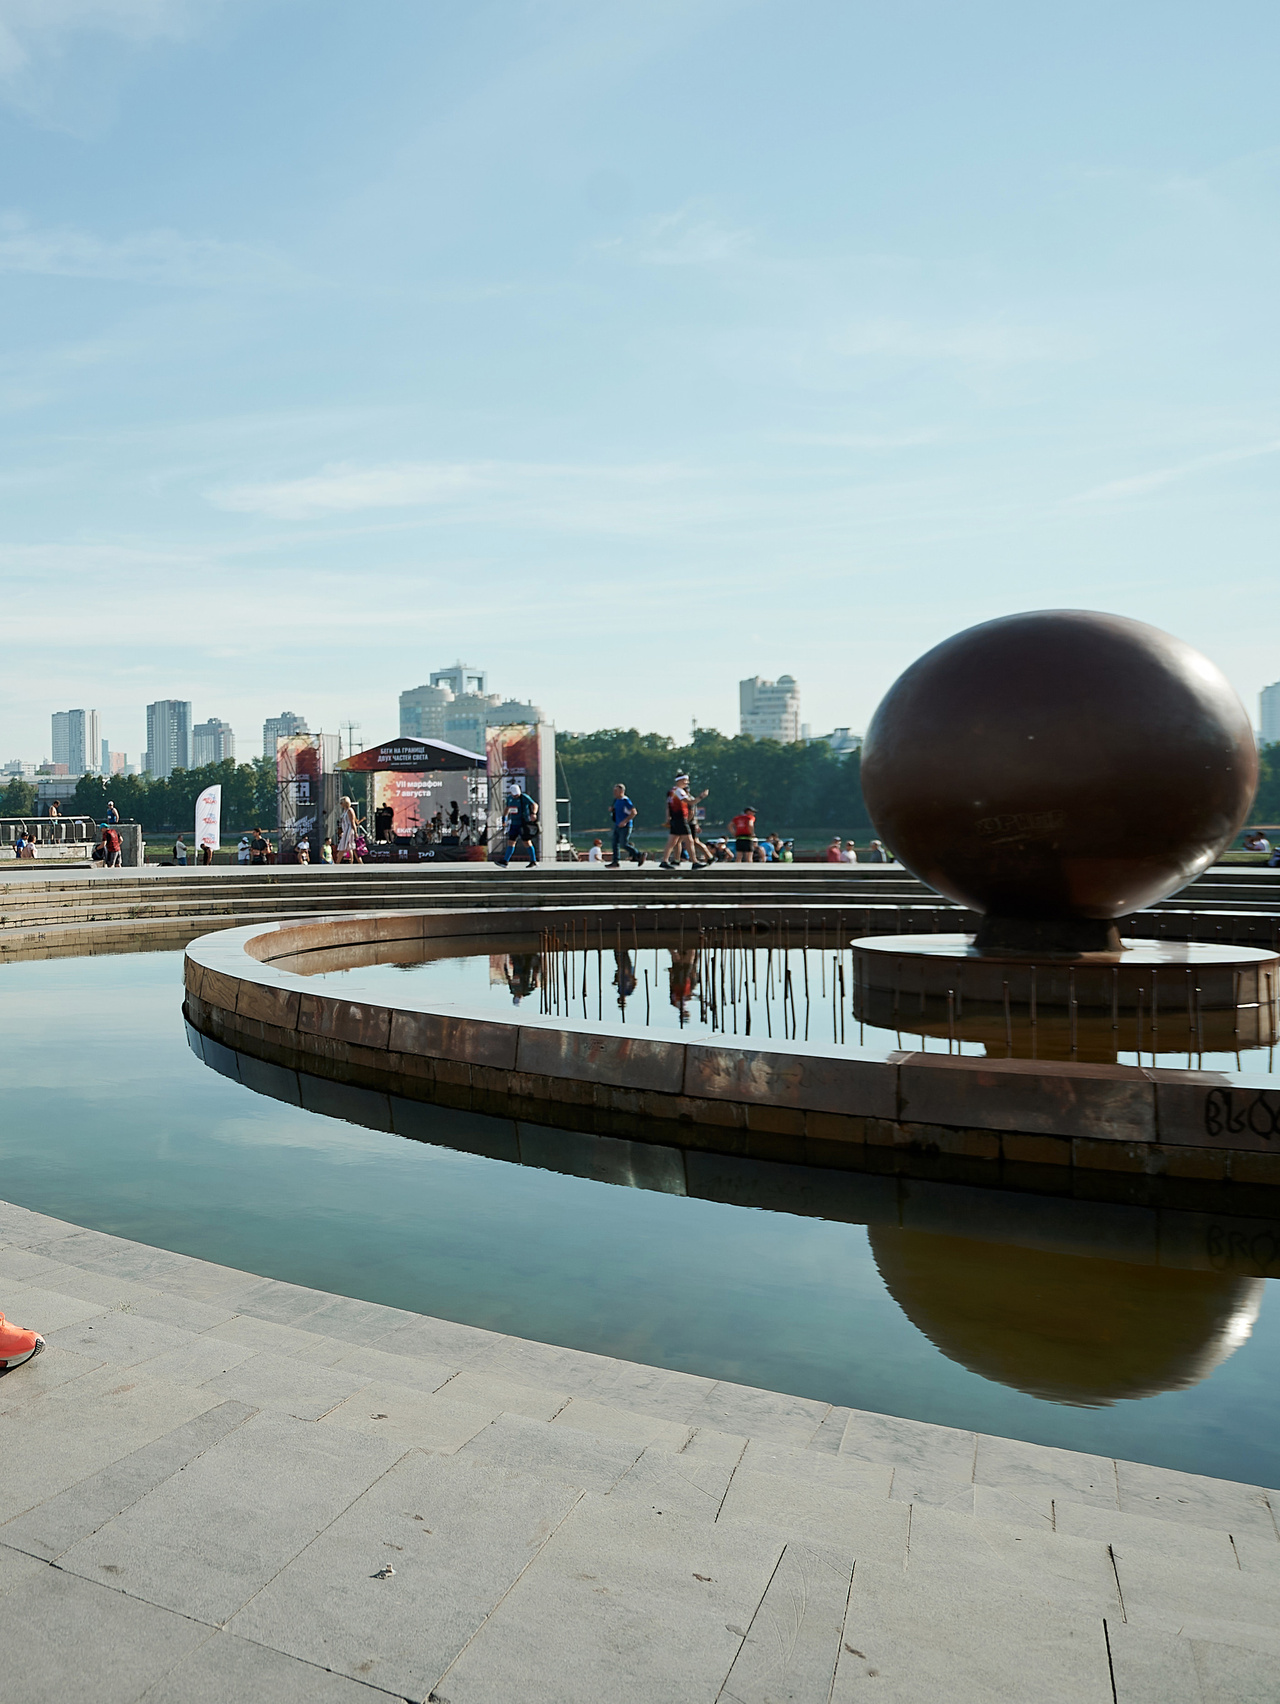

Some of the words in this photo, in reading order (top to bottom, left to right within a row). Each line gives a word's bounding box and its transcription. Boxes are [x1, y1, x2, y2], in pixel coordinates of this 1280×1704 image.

[402, 746, 425, 754] ГРАНИЦЕ
[407, 780, 443, 789] марафон
[401, 790, 432, 798] августа
